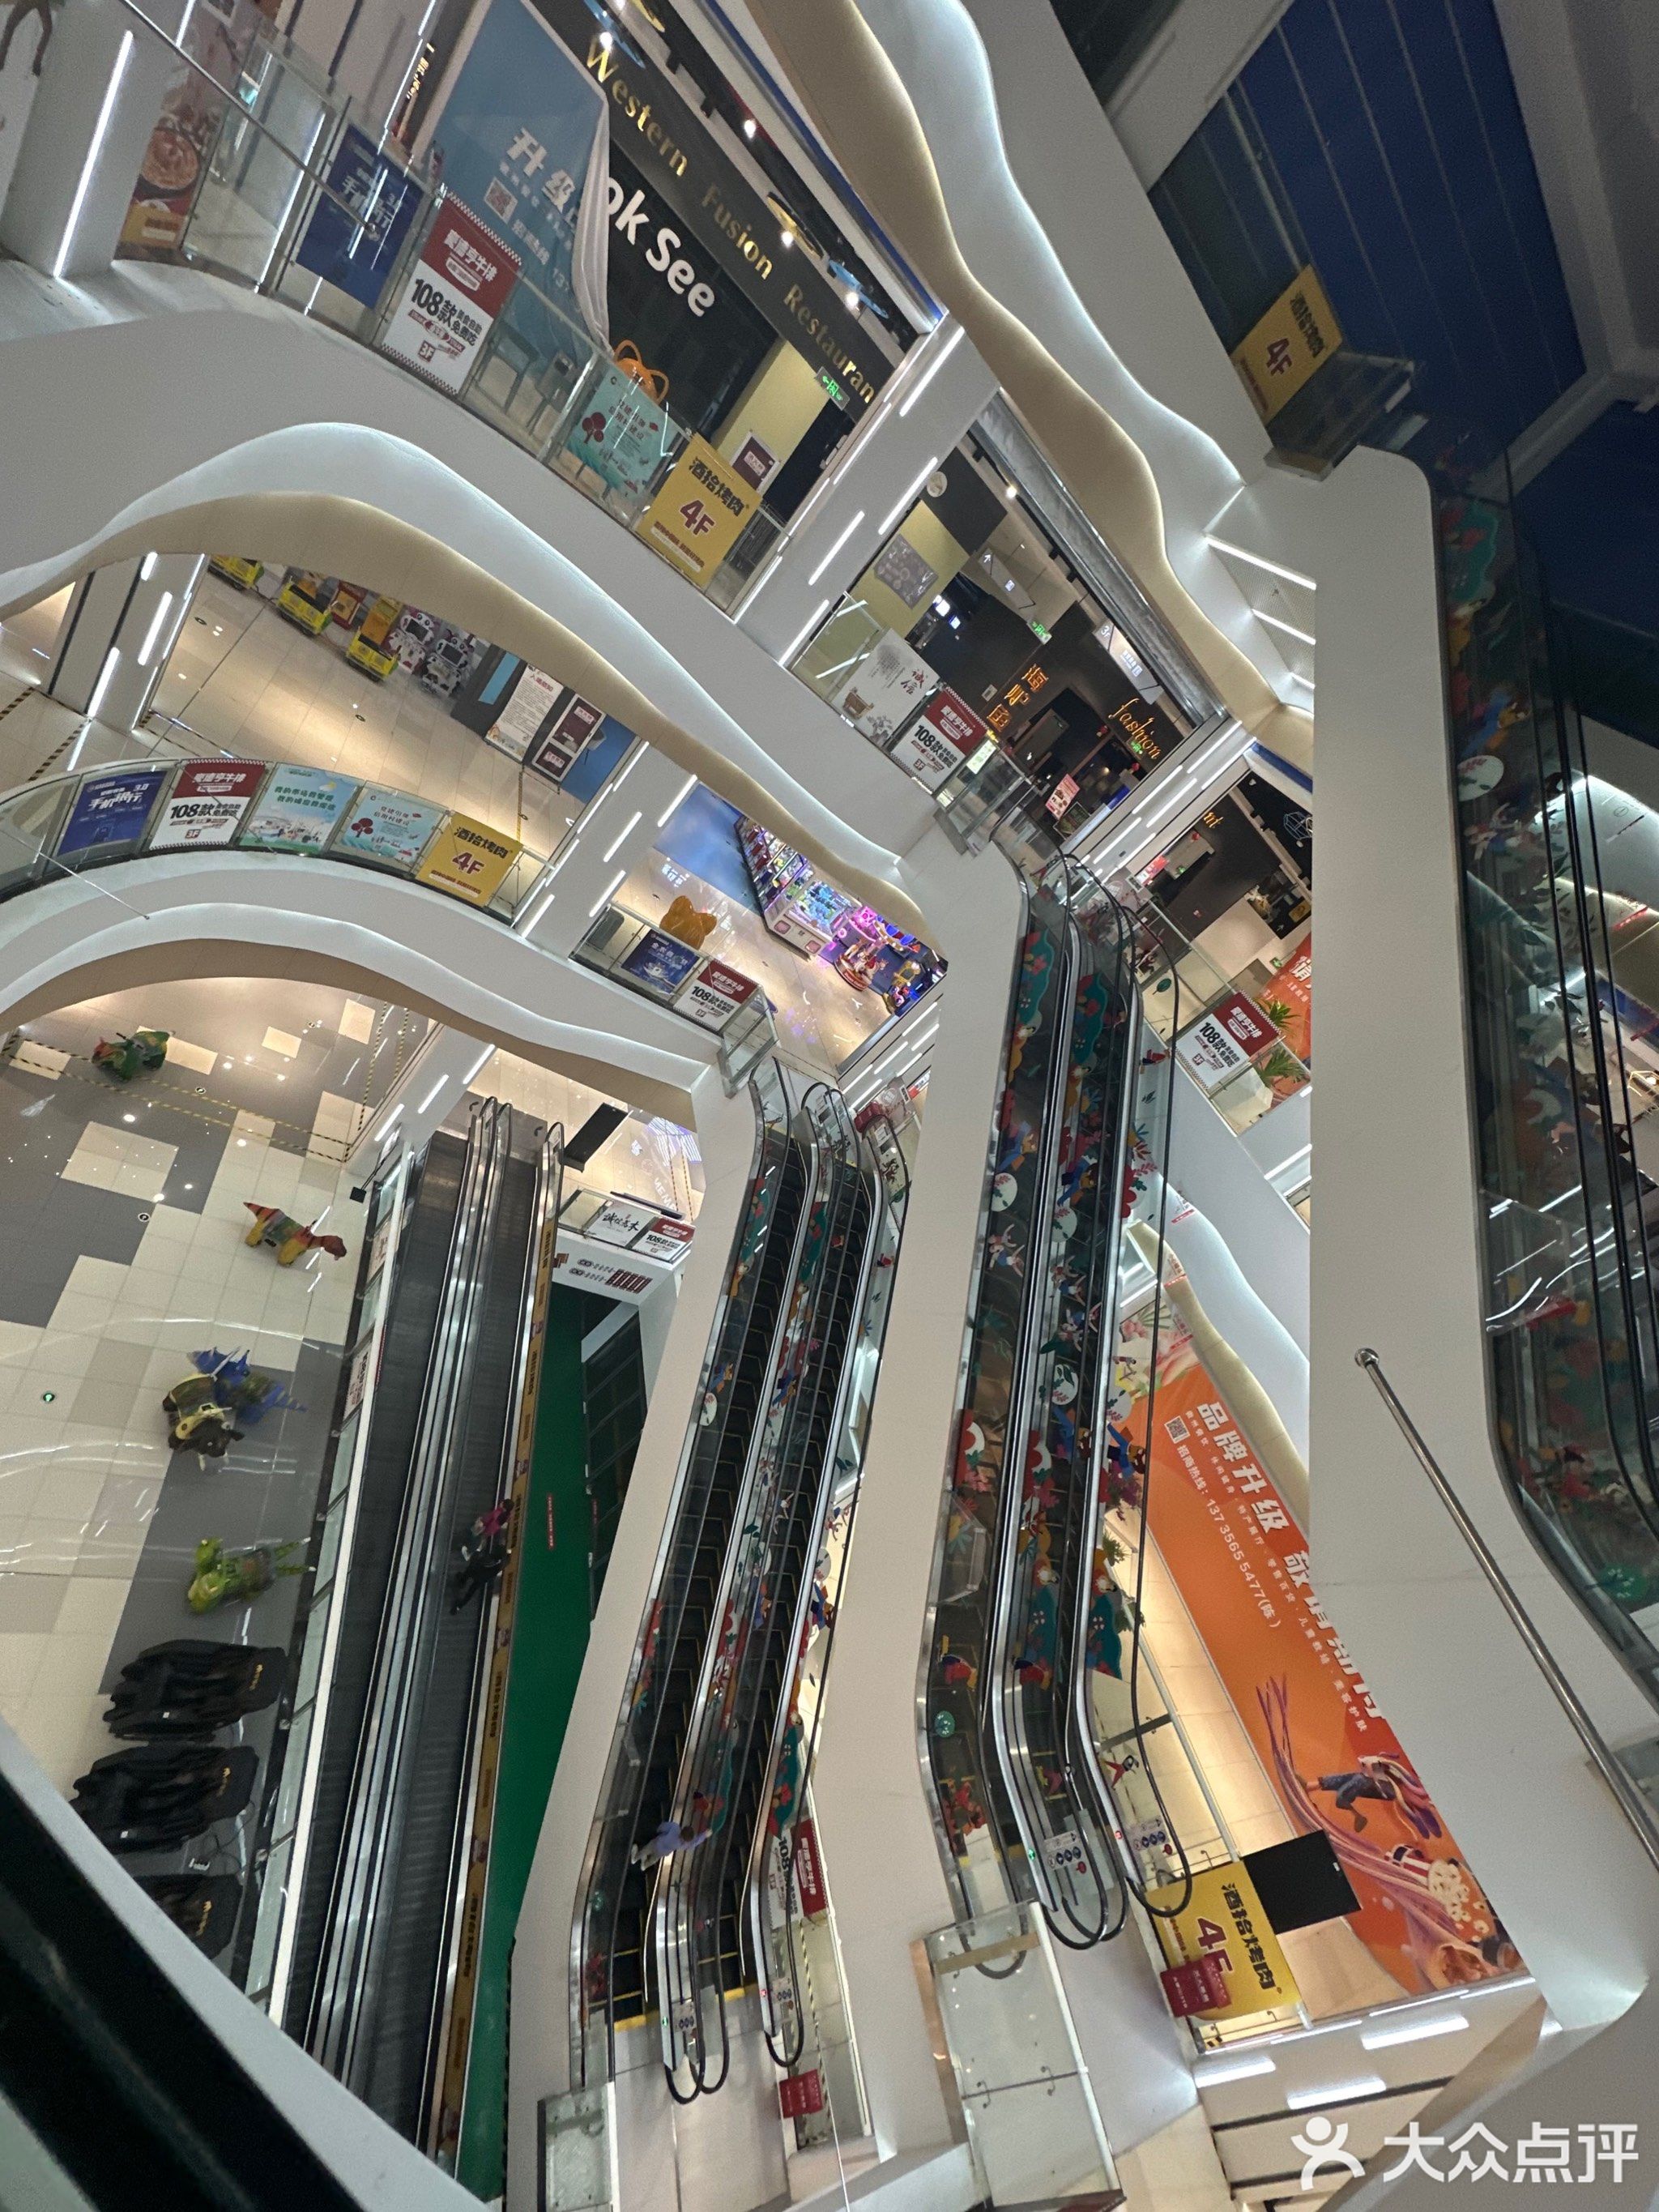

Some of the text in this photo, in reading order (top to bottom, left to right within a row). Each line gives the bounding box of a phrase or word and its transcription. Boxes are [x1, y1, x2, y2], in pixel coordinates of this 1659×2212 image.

[585, 37, 689, 178] Western
[698, 185, 778, 281] Fusion
[643, 225, 720, 318] See
[409, 277, 459, 327] 108款
[450, 319, 479, 346] 免费吃
[417, 342, 436, 361] 3F
[1265, 337, 1293, 377] 4F
[688, 457, 745, 516] 酒拾烤肉
[679, 499, 716, 540] 4F
[1099, 625, 1113, 641] 3F
[913, 724, 944, 754] 108款
[1107, 693, 1164, 761] fashion
[913, 758, 925, 771] 3F
[134, 783, 148, 792] 3.0
[169, 803, 214, 818] 108款
[185, 829, 201, 838] 3F
[453, 826, 509, 859] 酒拾烤肉
[452, 851, 484, 874] 4F
[692, 985, 720, 1006] 108款
[1198, 1021, 1227, 1053] 108款
[1192, 1053, 1205, 1065] 3F
[1196, 1400, 1290, 1533] 品牌升级
[1205, 1497, 1223, 1522] 137
[1218, 1523, 1244, 1561] 3565
[1220, 1881, 1276, 1990] 酒拾烤肉
